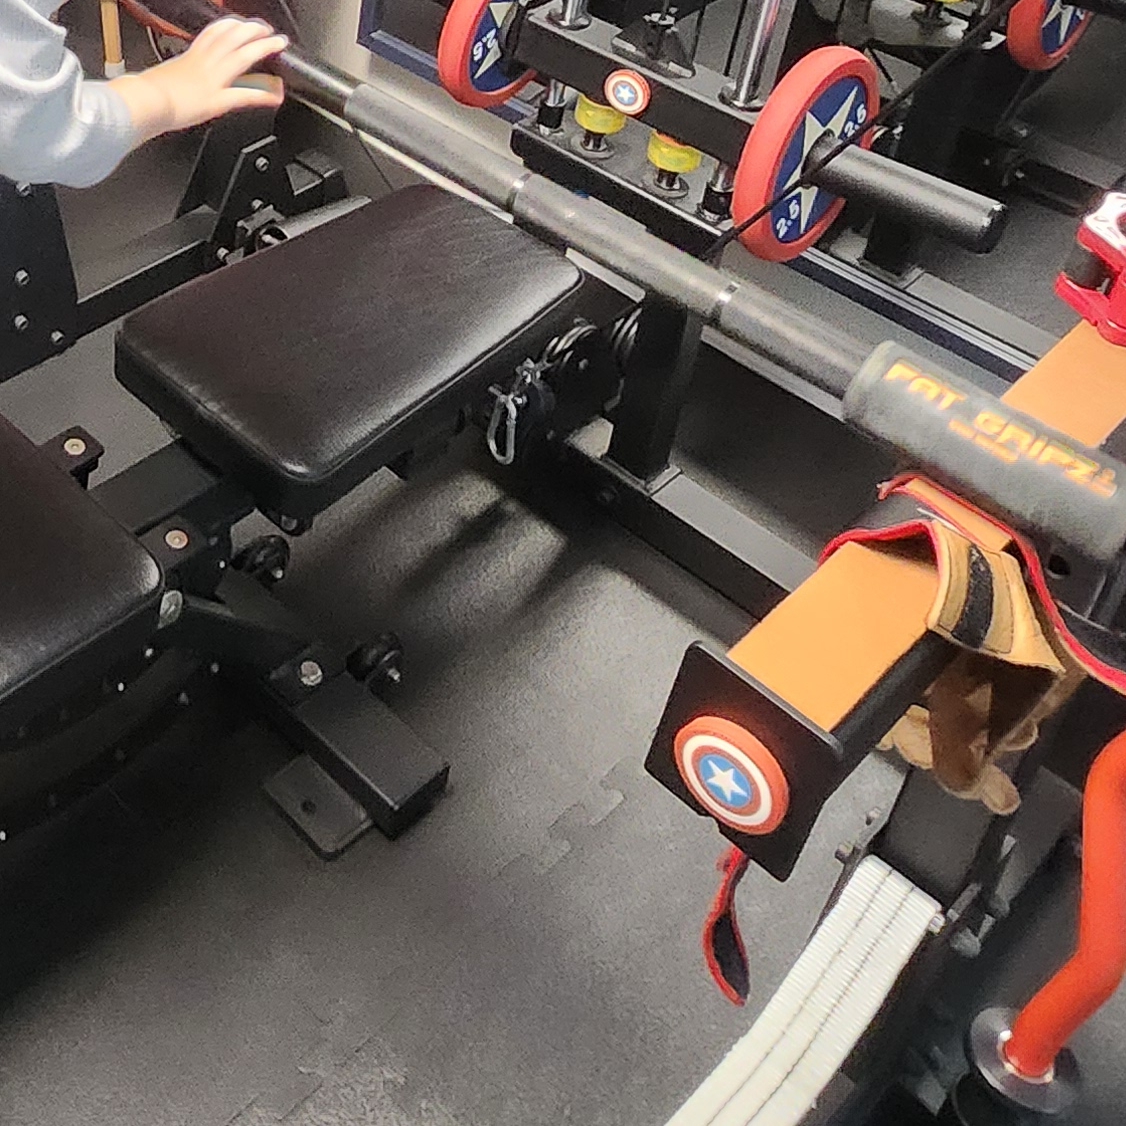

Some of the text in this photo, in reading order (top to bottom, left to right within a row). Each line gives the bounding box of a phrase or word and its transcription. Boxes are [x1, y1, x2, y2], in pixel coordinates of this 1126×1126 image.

[844, 103, 867, 138] 2.5
[776, 199, 800, 239] 2.5
[883, 361, 966, 411] FAT
